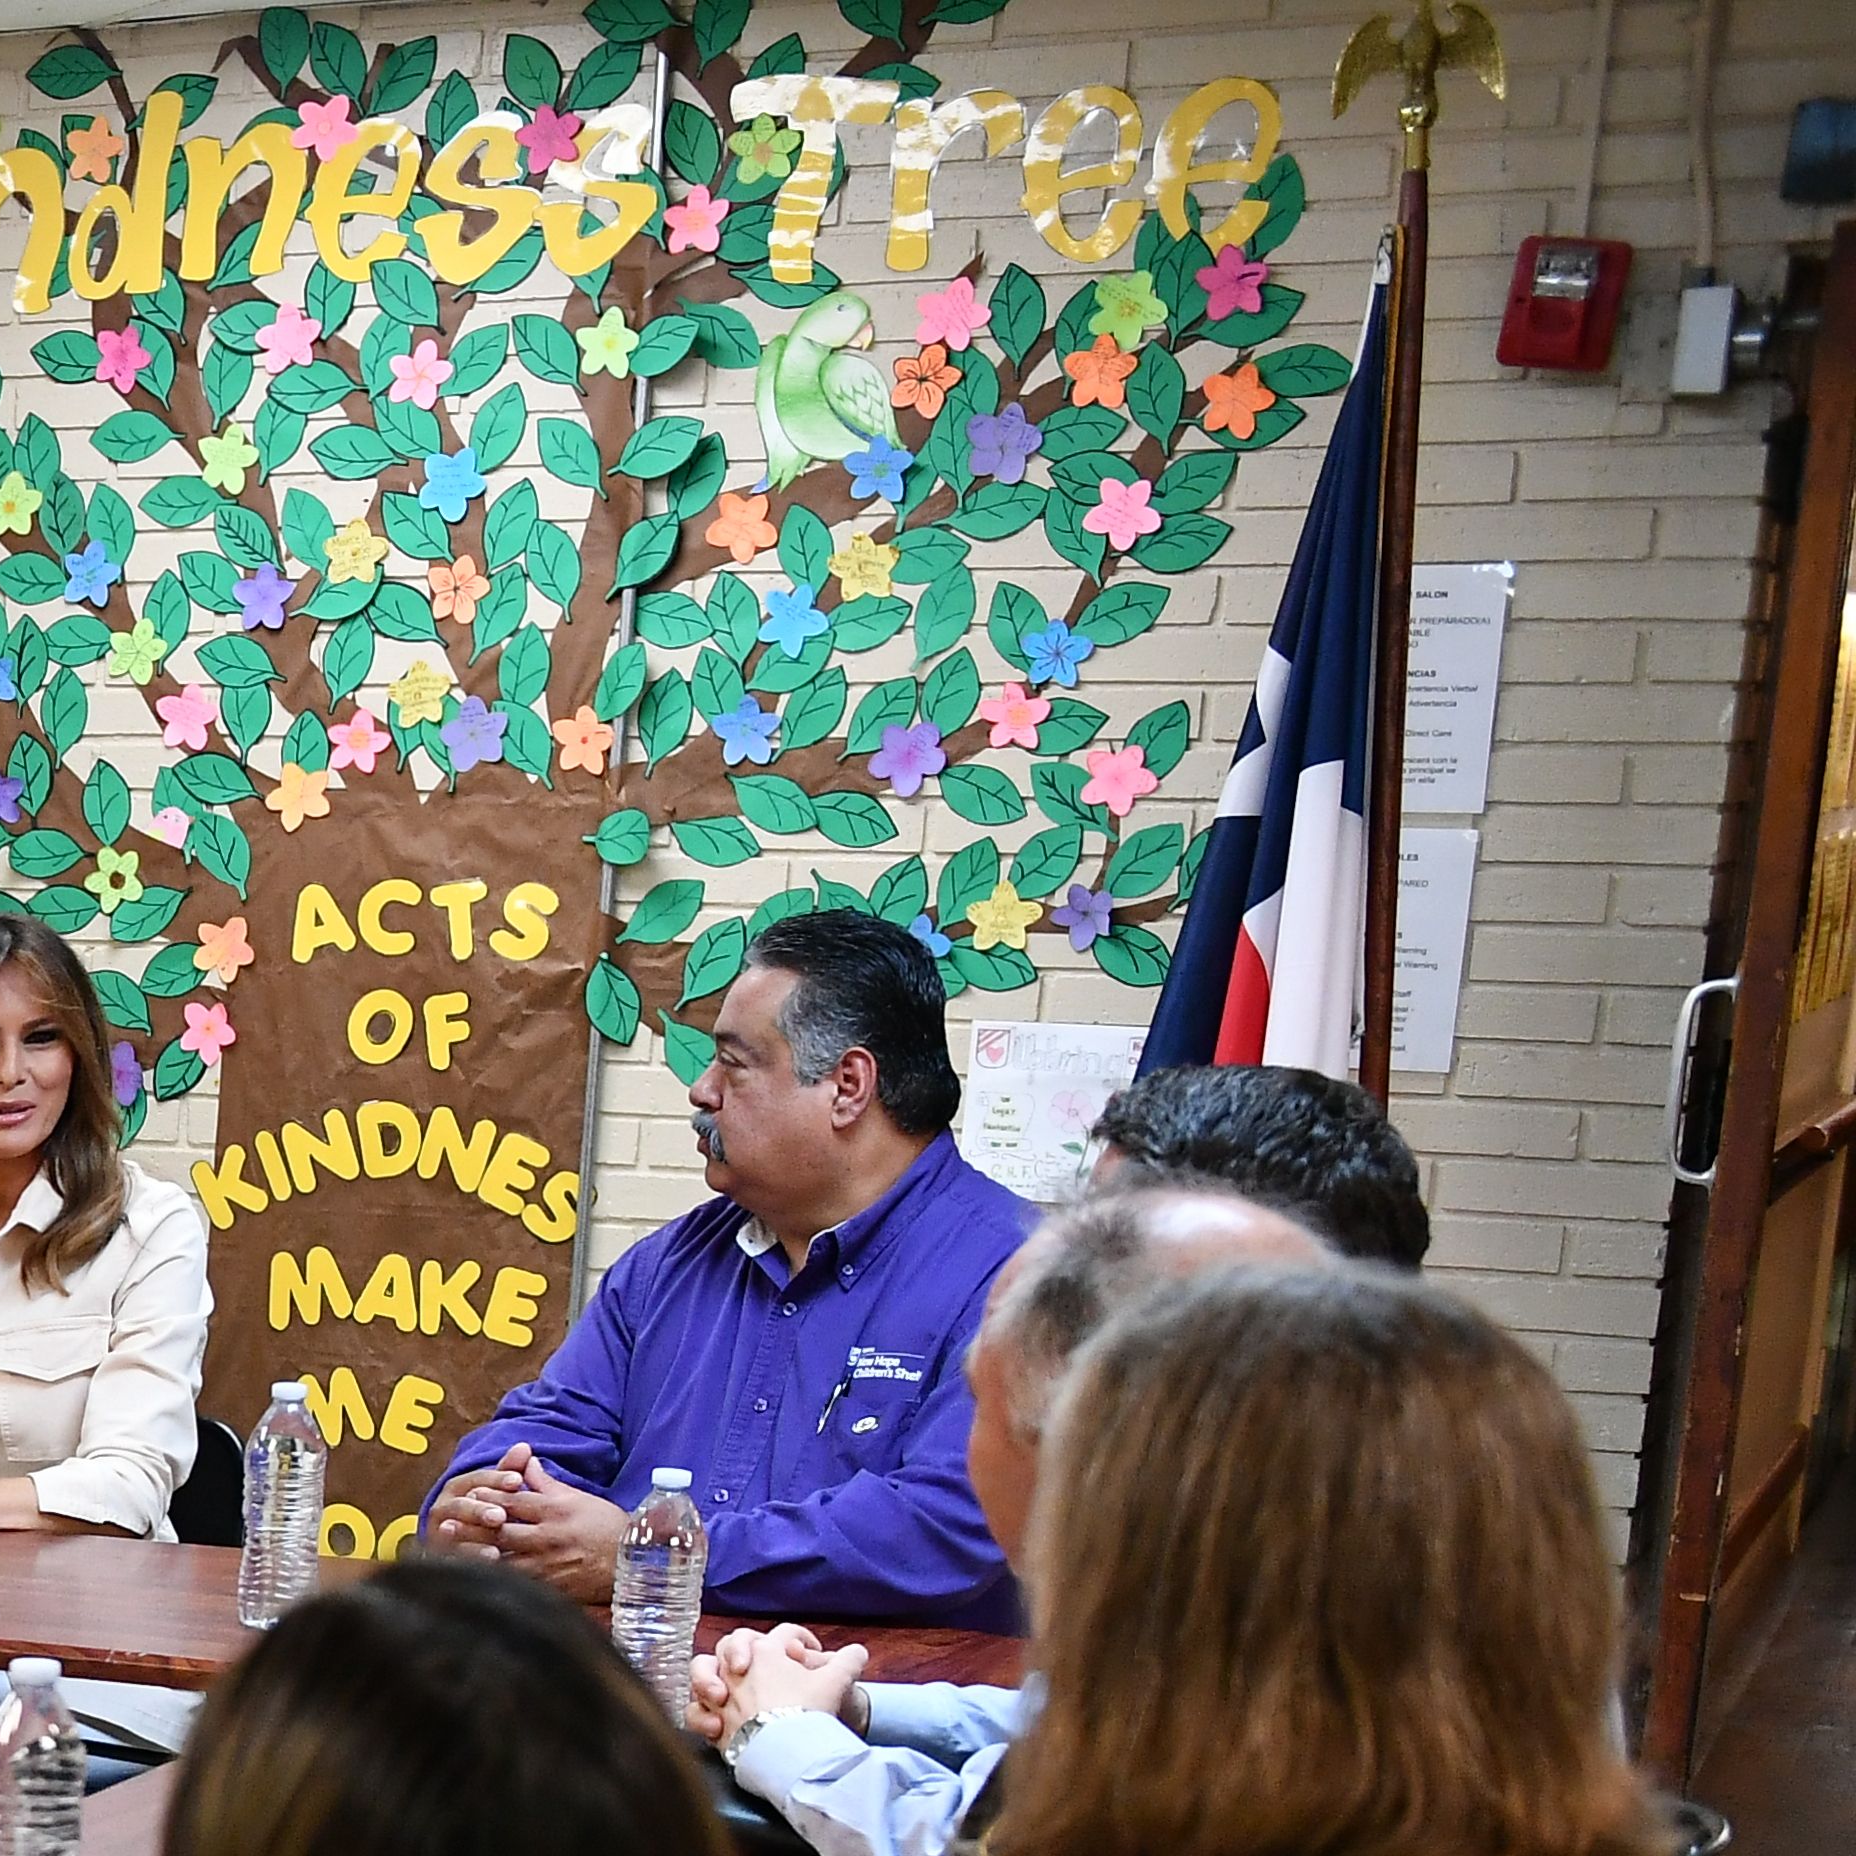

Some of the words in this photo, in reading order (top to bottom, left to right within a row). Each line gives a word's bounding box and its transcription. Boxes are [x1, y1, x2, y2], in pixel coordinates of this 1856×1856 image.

[729, 74, 1282, 284] Tree
[292, 878, 560, 964] ACTS
[347, 988, 472, 1072] OF
[269, 1245, 548, 1348] MAKE
[874, 1355, 901, 1369] Hope
[300, 1366, 445, 1455] ME
